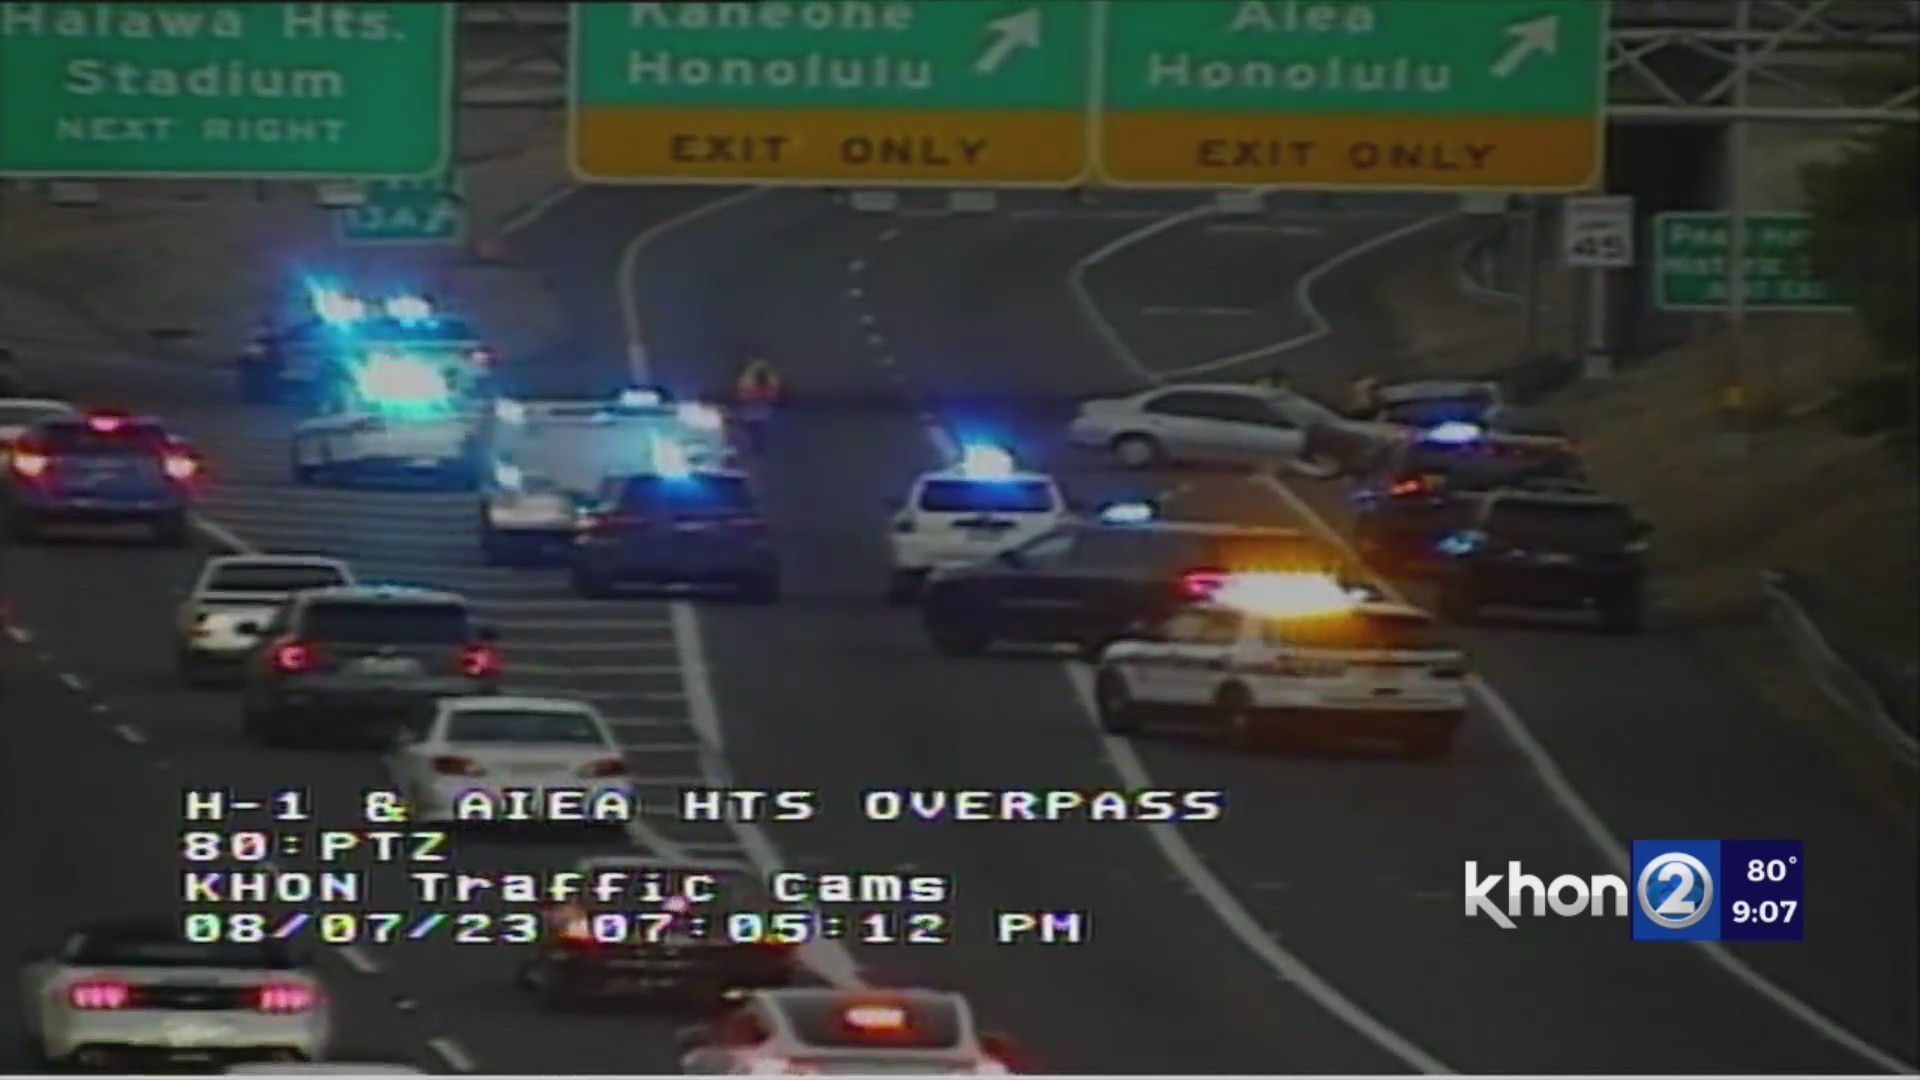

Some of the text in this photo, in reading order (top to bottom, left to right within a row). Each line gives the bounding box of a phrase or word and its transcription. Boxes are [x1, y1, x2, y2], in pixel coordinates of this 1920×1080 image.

[0, 3, 405, 40] Halawa Hts.
[64, 58, 345, 98] Stadium
[627, 49, 932, 88] Honolulu
[1148, 53, 1451, 91] Honolulu
[55, 116, 350, 142] NEXT RIGHT
[668, 133, 988, 166] EXIT ONLY
[1196, 139, 1498, 171] EXIT ONLY
[1573, 234, 1627, 258] 45
